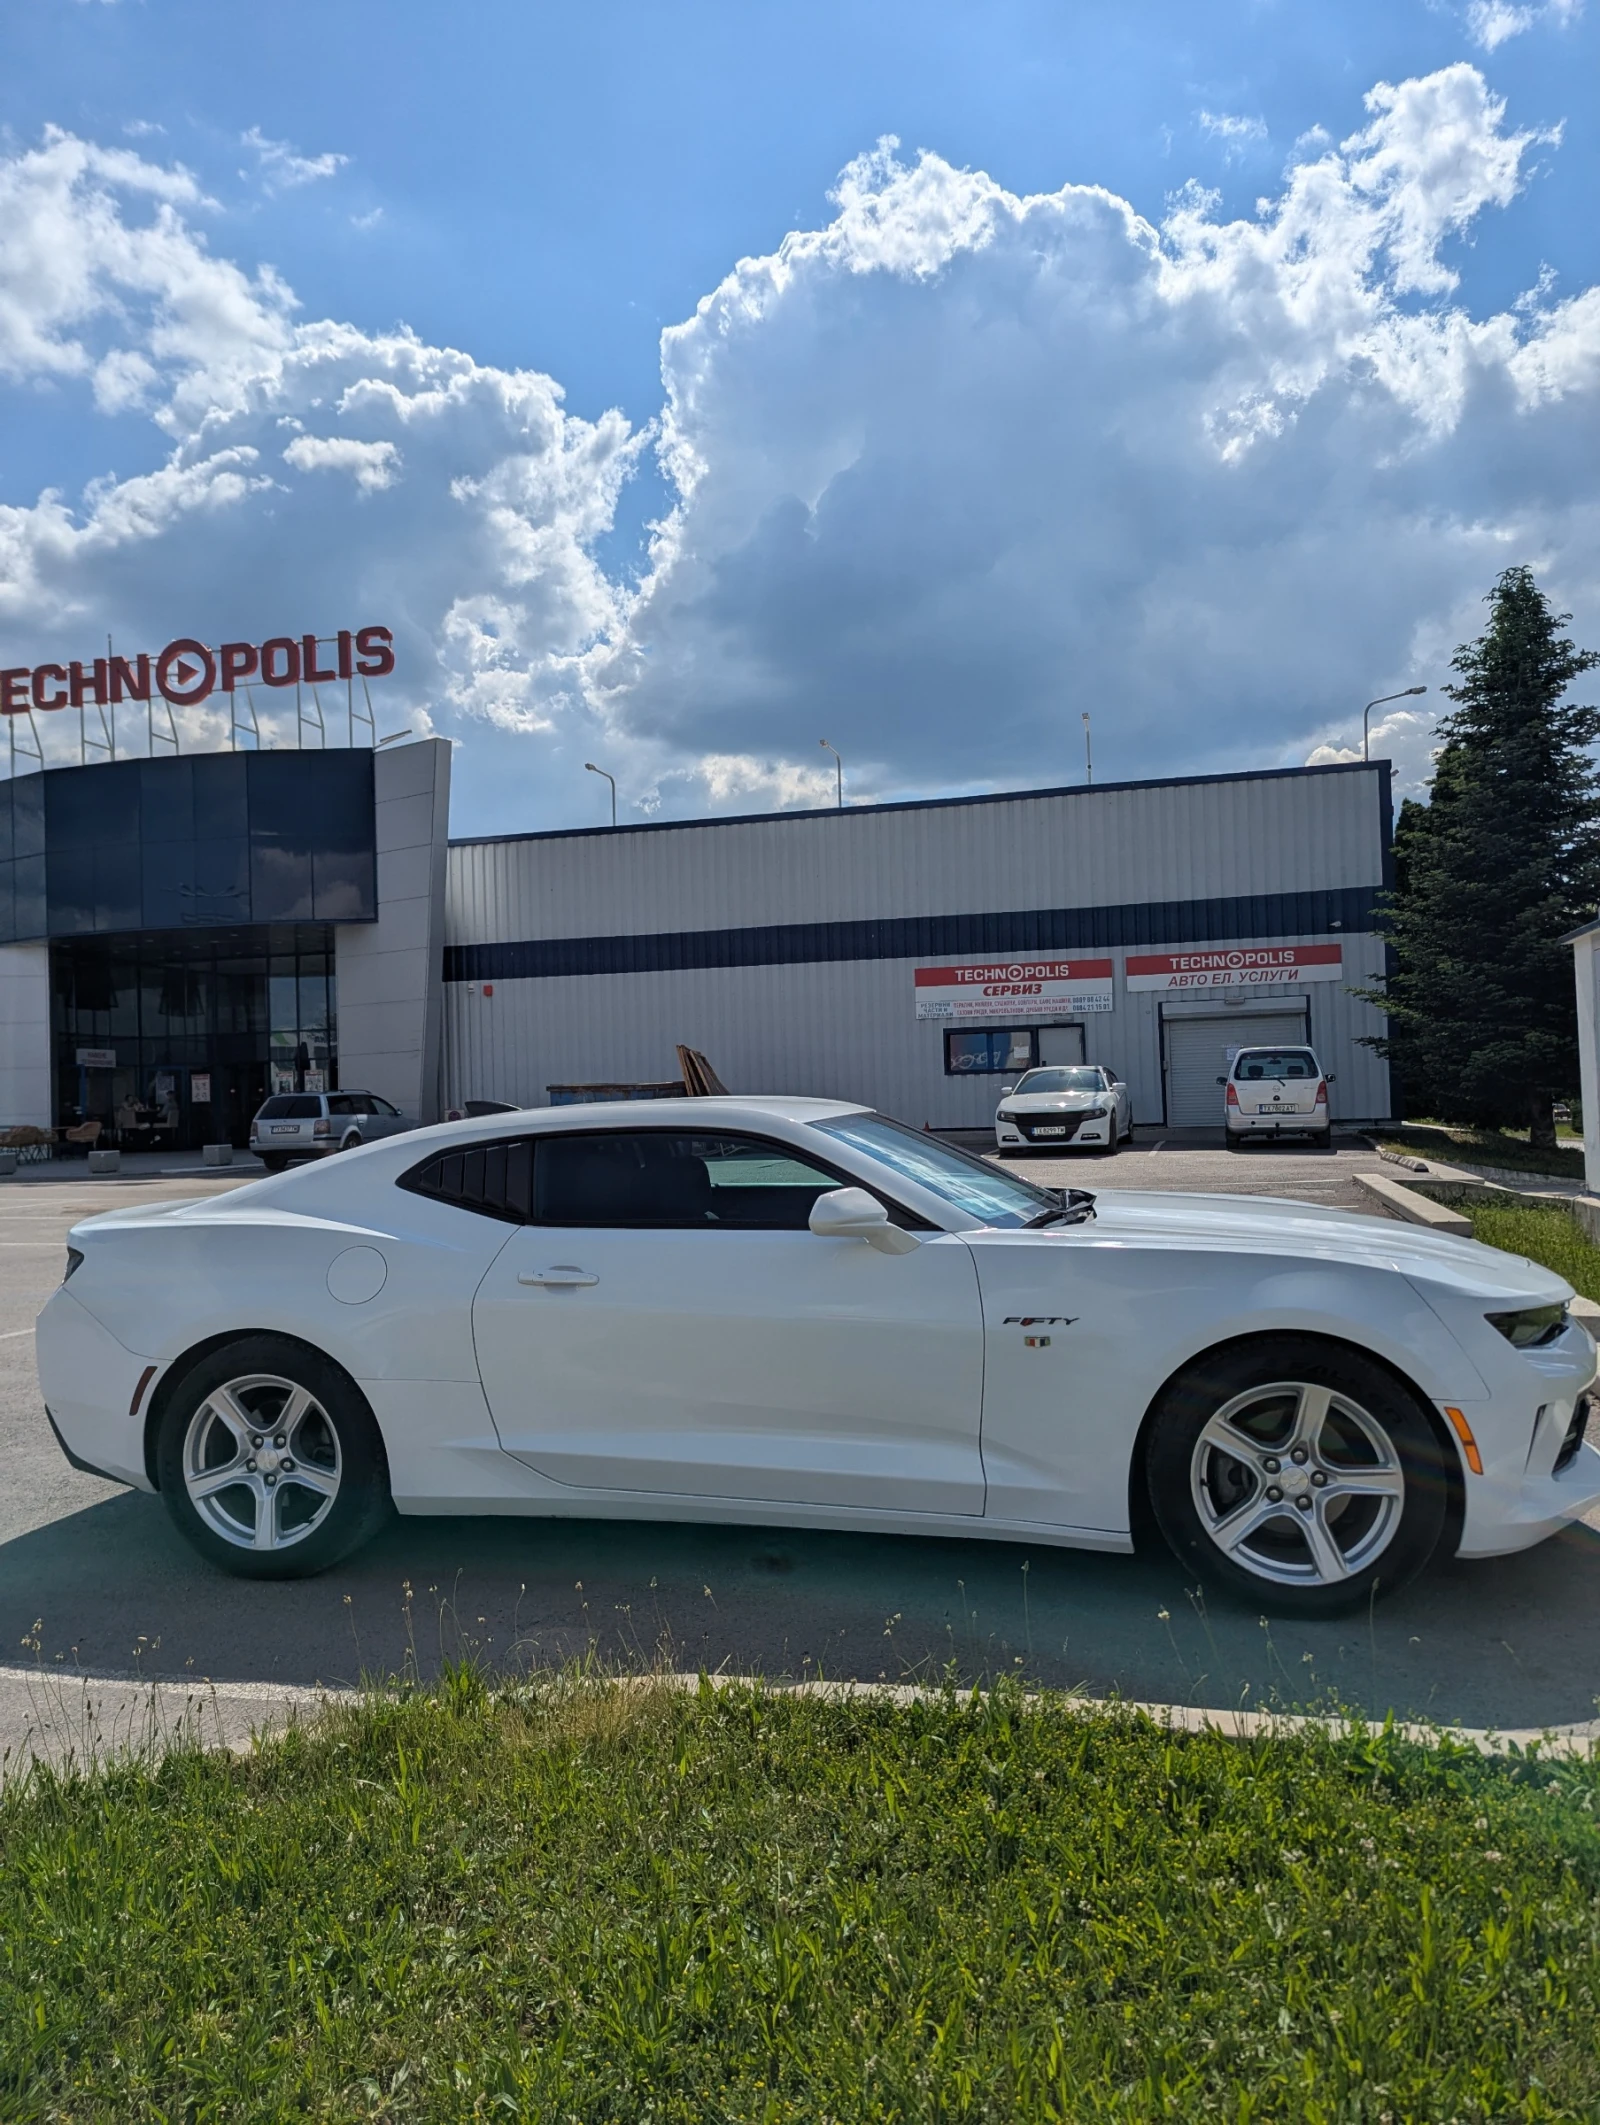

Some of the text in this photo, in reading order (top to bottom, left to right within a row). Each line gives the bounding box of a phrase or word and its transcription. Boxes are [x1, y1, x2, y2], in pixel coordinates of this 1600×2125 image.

[1169, 950, 1295, 970] TECHNOPOLIS
[955, 964, 1069, 982] TECHNOPOLIS
[1168, 969, 1299, 988] АВТО ЕЛ. УСЛУГИ
[982, 983, 1043, 997] СЕРВИЗ
